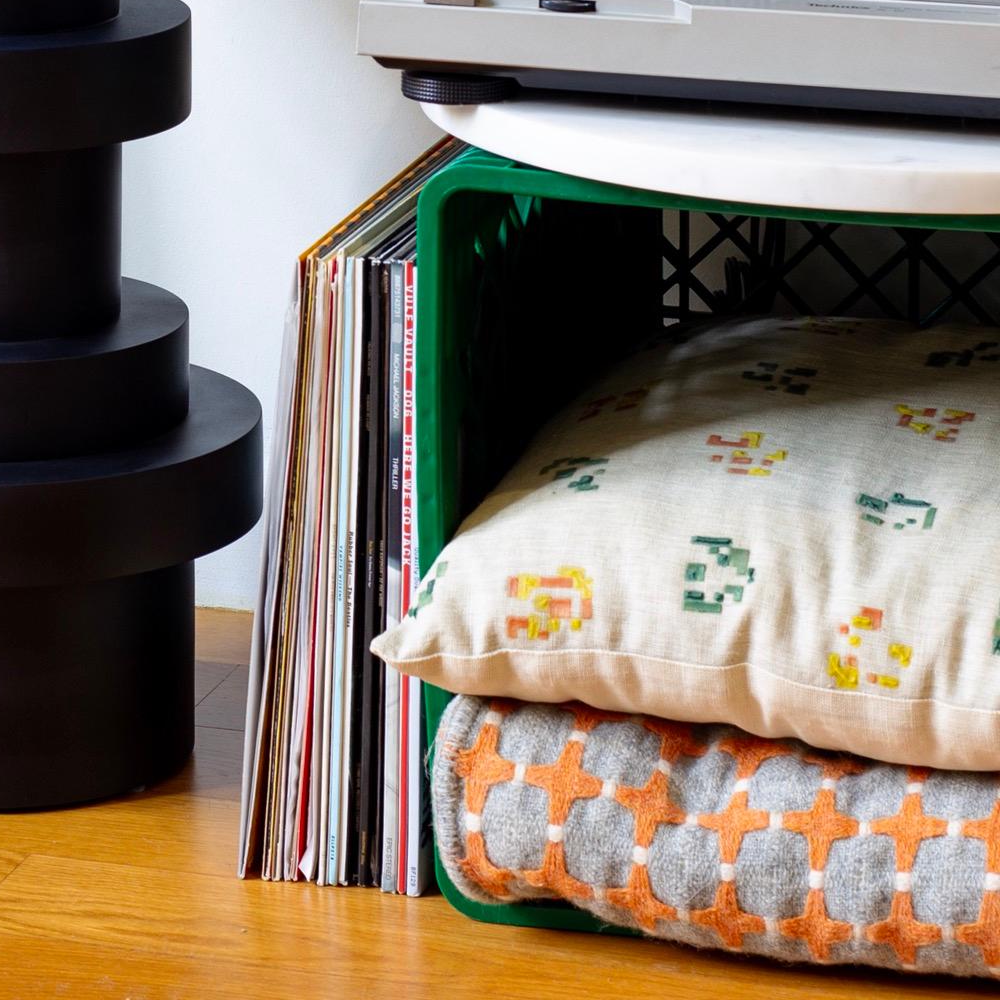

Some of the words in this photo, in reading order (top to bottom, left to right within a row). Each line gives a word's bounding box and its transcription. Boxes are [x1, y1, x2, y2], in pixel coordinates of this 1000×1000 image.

[404, 328, 413, 371] VAULT
[403, 434, 412, 471] HERE
[391, 456, 399, 490] THRILLER
[403, 480, 412, 499] WE
[402, 506, 411, 525] GO
[402, 531, 411, 566] JACK
[385, 837, 393, 853] EPIC
[385, 854, 393, 881] STEREO
